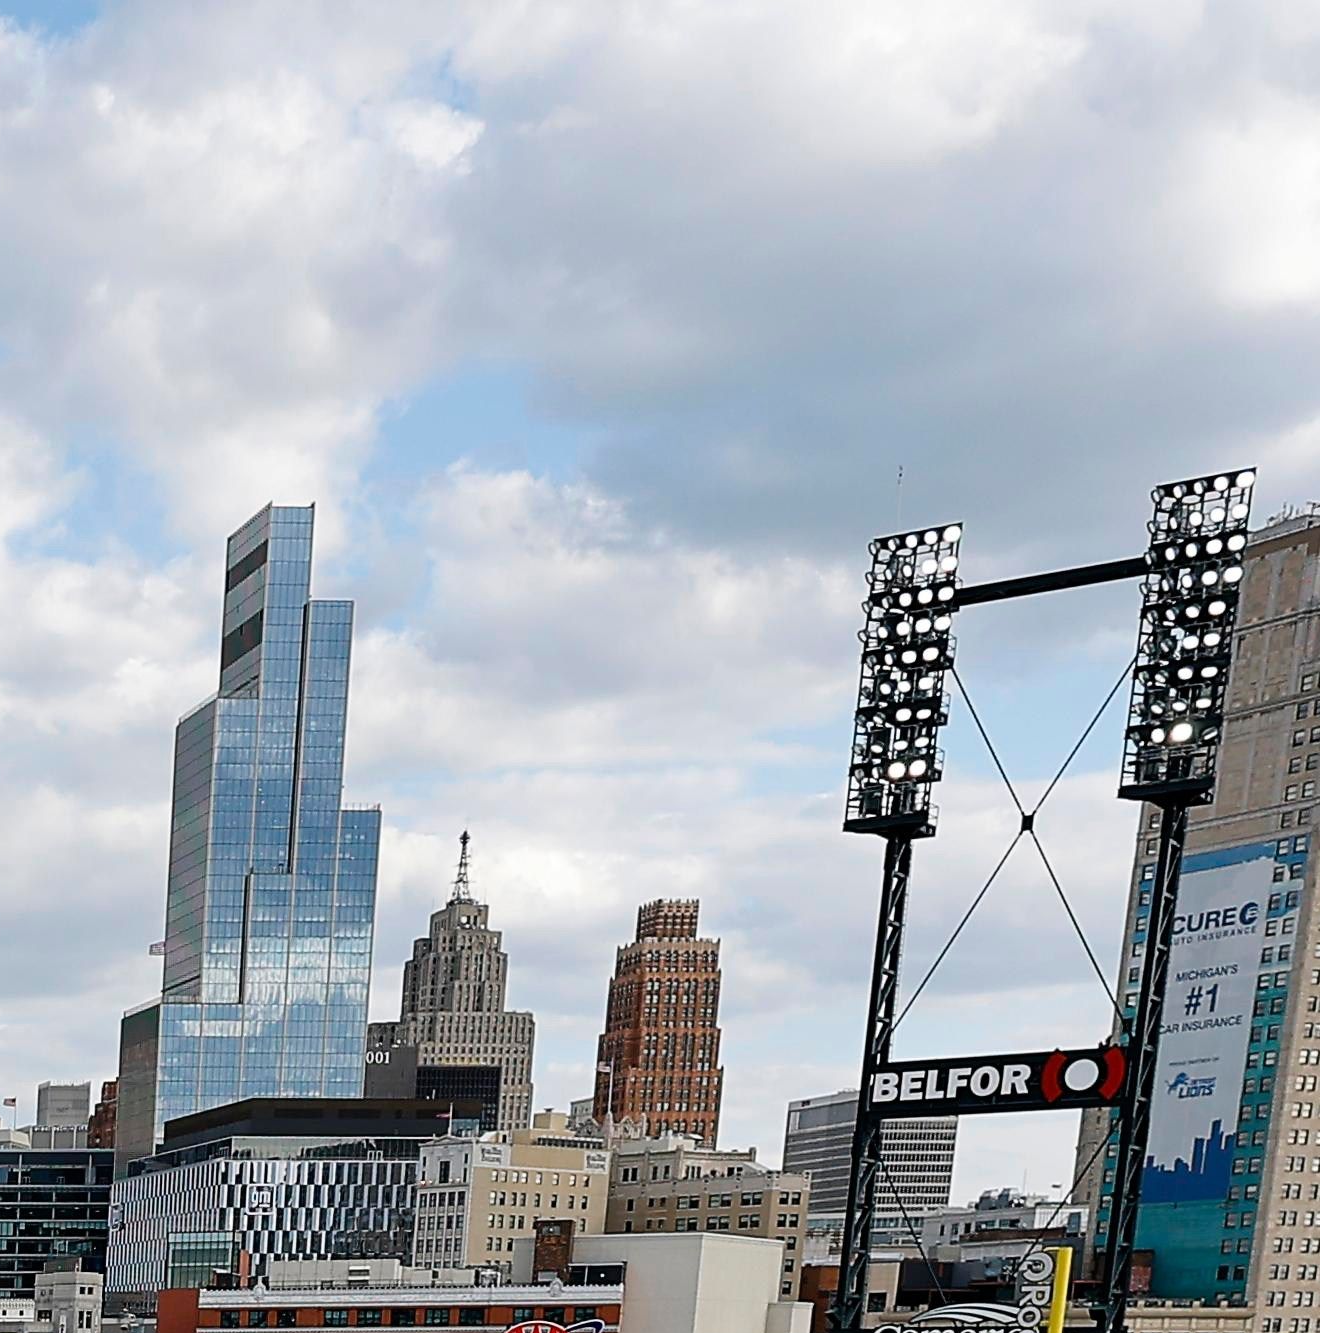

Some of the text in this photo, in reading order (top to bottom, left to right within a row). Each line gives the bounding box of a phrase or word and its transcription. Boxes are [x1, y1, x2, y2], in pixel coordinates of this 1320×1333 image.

[1172, 907, 1237, 936] CURE
[1197, 926, 1257, 943] INSURANCE
[1175, 964, 1239, 983] MICHIGAN'S
[1184, 983, 1219, 1017] #1
[1181, 1014, 1244, 1033] INSURANCE
[873, 1064, 1032, 1105] BELFOR
